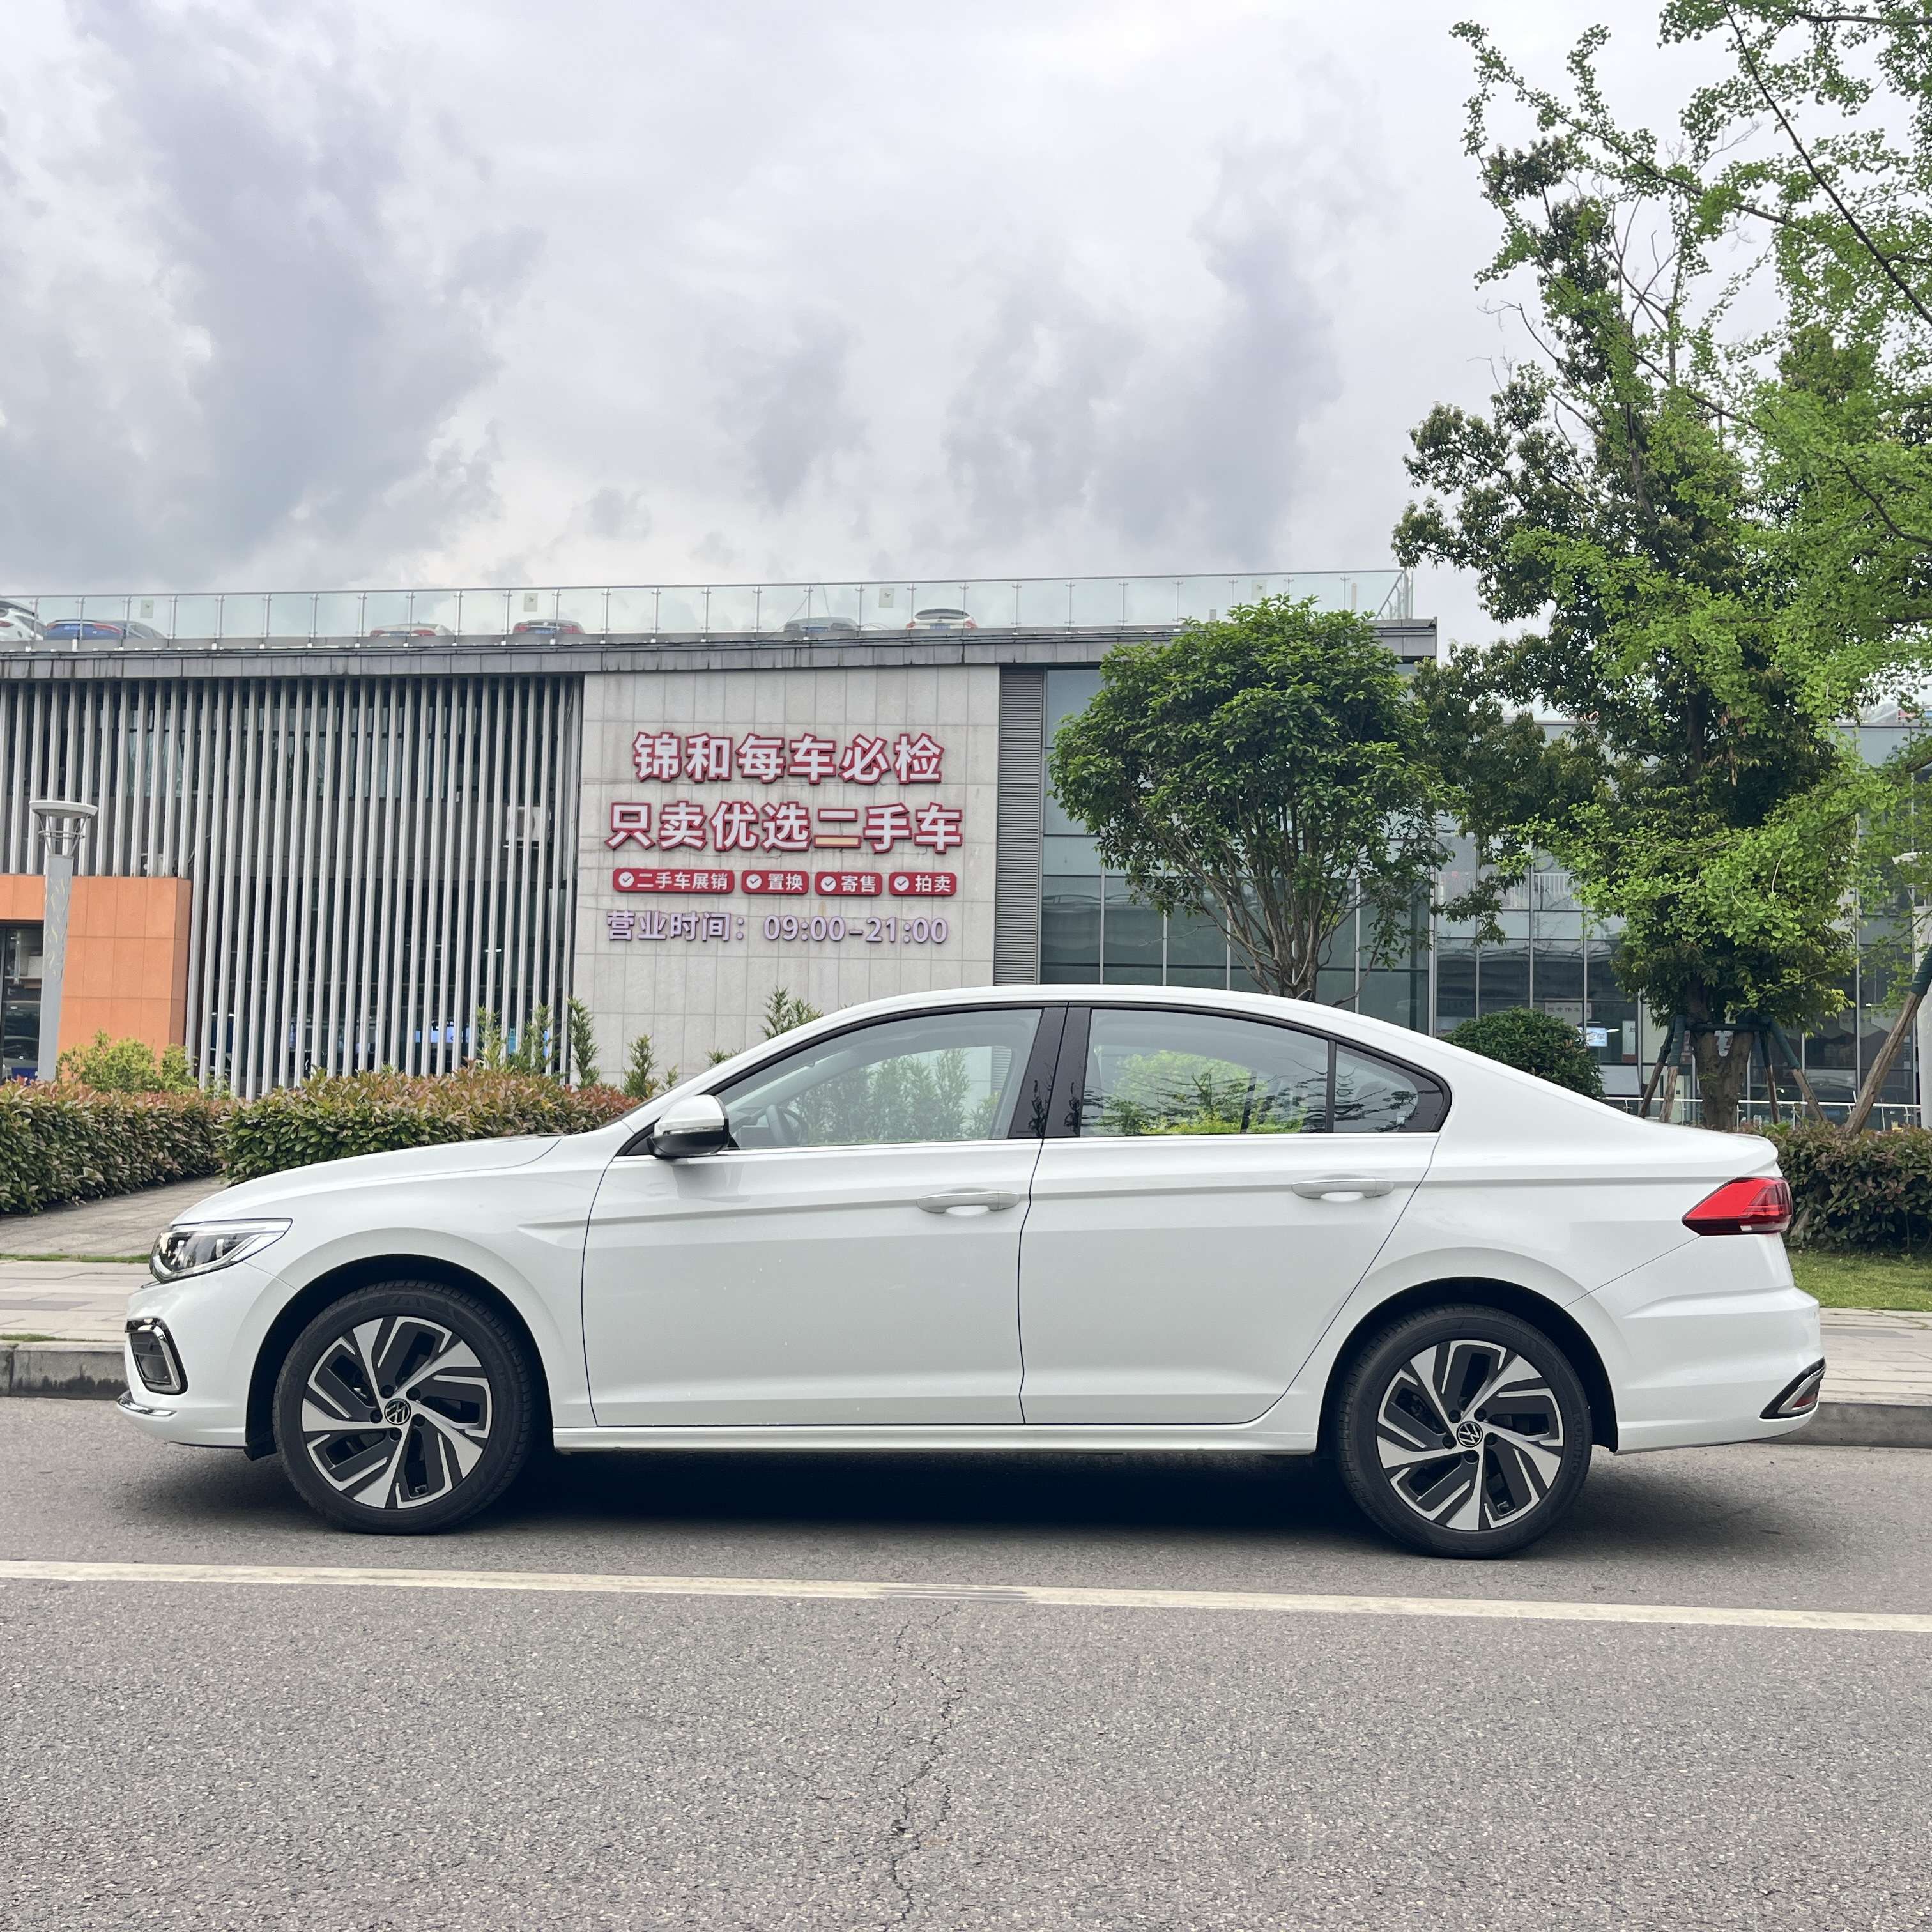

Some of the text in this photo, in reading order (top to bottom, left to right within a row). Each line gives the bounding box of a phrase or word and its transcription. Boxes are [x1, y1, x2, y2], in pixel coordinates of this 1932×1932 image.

[634, 731, 944, 783] 锦和每车必检
[605, 800, 963, 854] 只卖优选二手车
[637, 871, 728, 890] 二手车展销
[767, 873, 803, 891] 置换
[841, 875, 876, 893] 寄售
[915, 875, 951, 893] 拍卖
